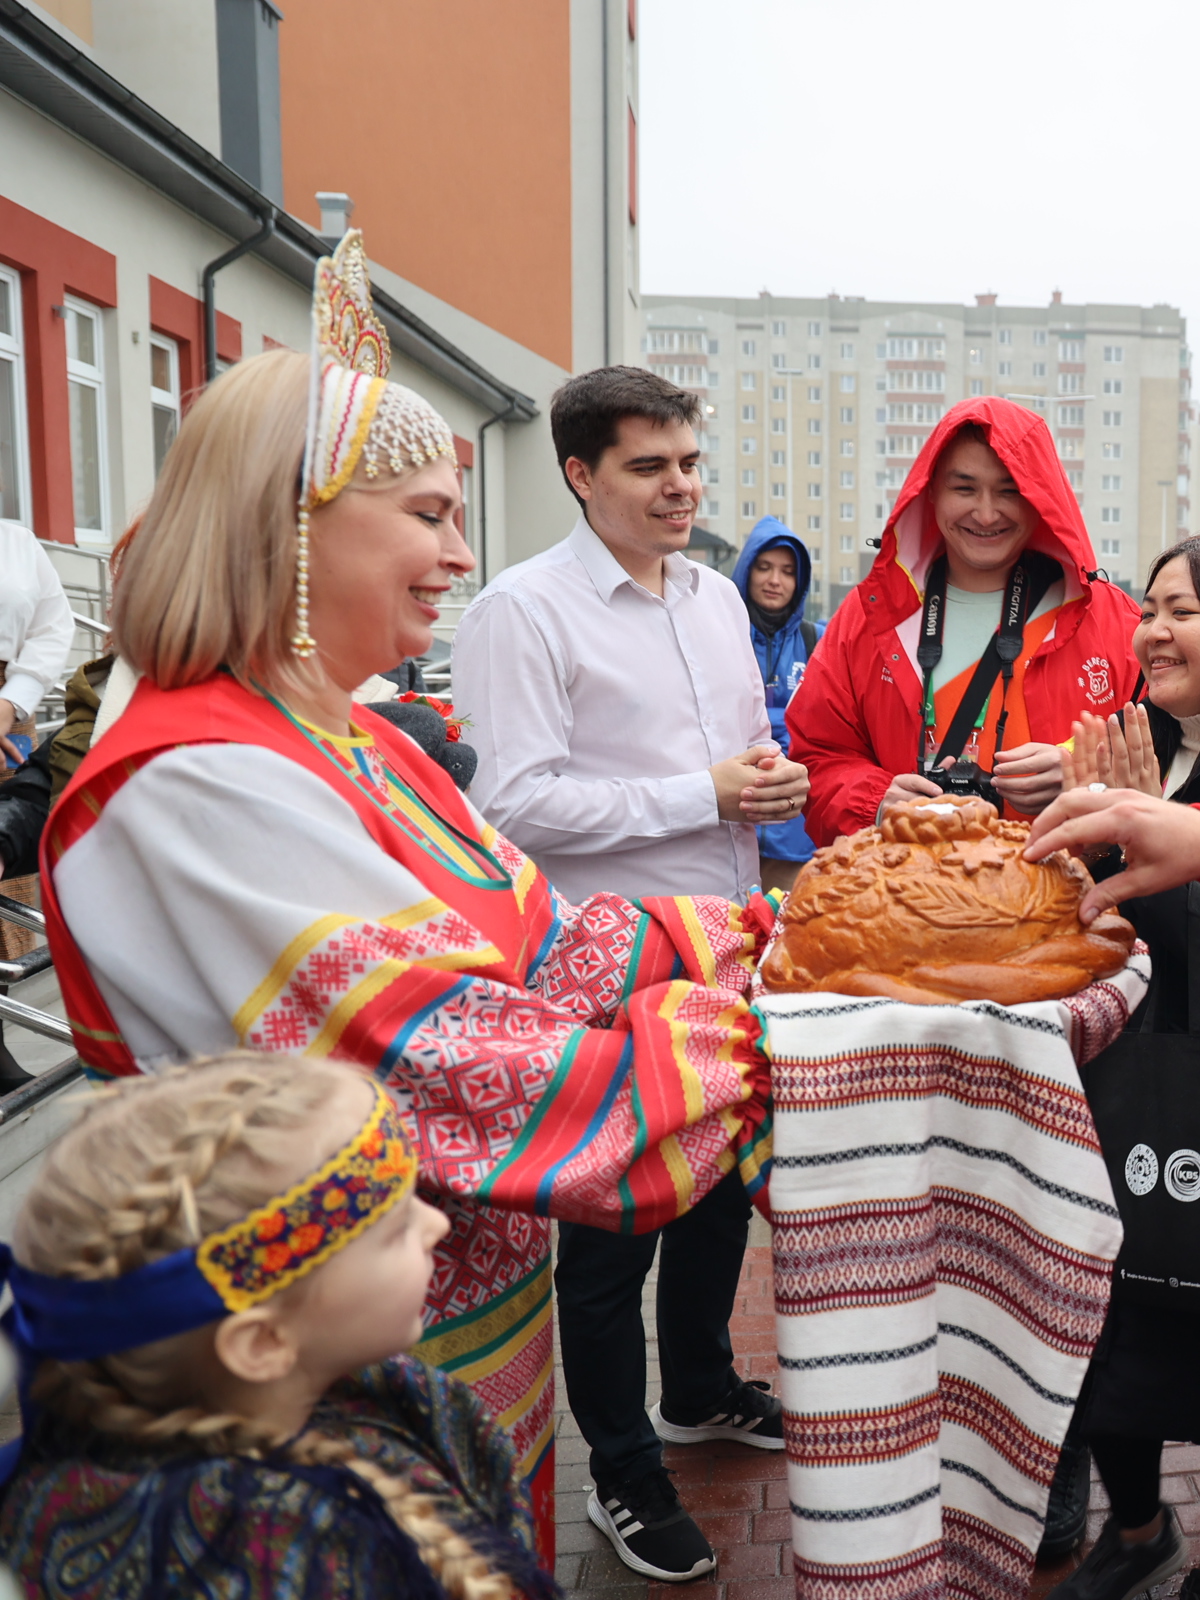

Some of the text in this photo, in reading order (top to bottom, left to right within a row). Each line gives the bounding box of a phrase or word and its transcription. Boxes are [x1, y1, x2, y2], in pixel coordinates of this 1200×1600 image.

[925, 594, 940, 636] Canon
[1008, 585, 1022, 627] DIGITAL
[1179, 1170, 1199, 1182] KBS
